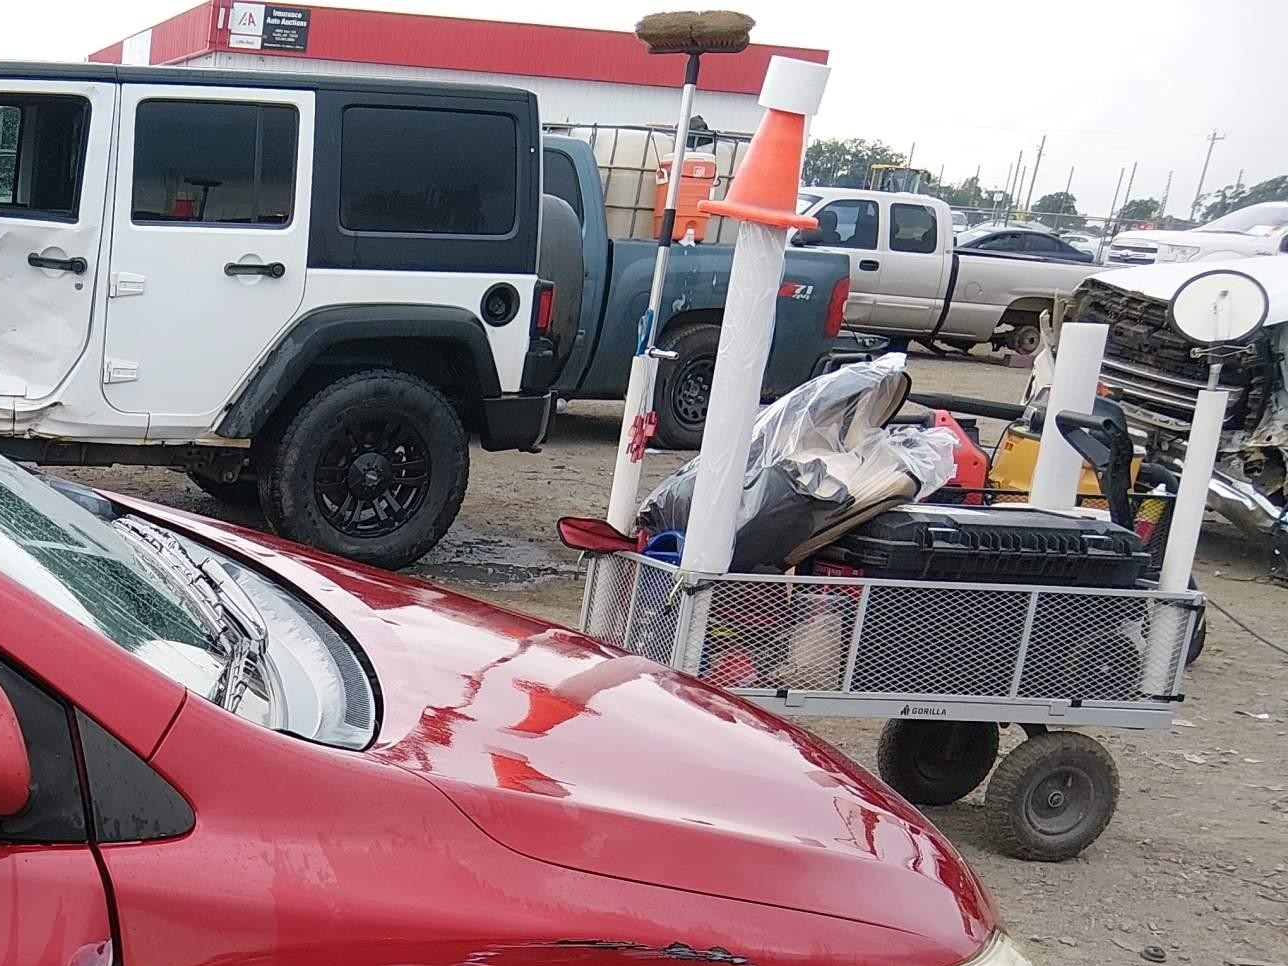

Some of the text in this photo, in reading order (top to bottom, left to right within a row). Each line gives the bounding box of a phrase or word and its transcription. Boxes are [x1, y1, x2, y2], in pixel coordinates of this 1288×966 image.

[272, 9, 302, 18] Insurance
[280, 18, 307, 27] Auctions
[912, 707, 947, 716] GORILLA
